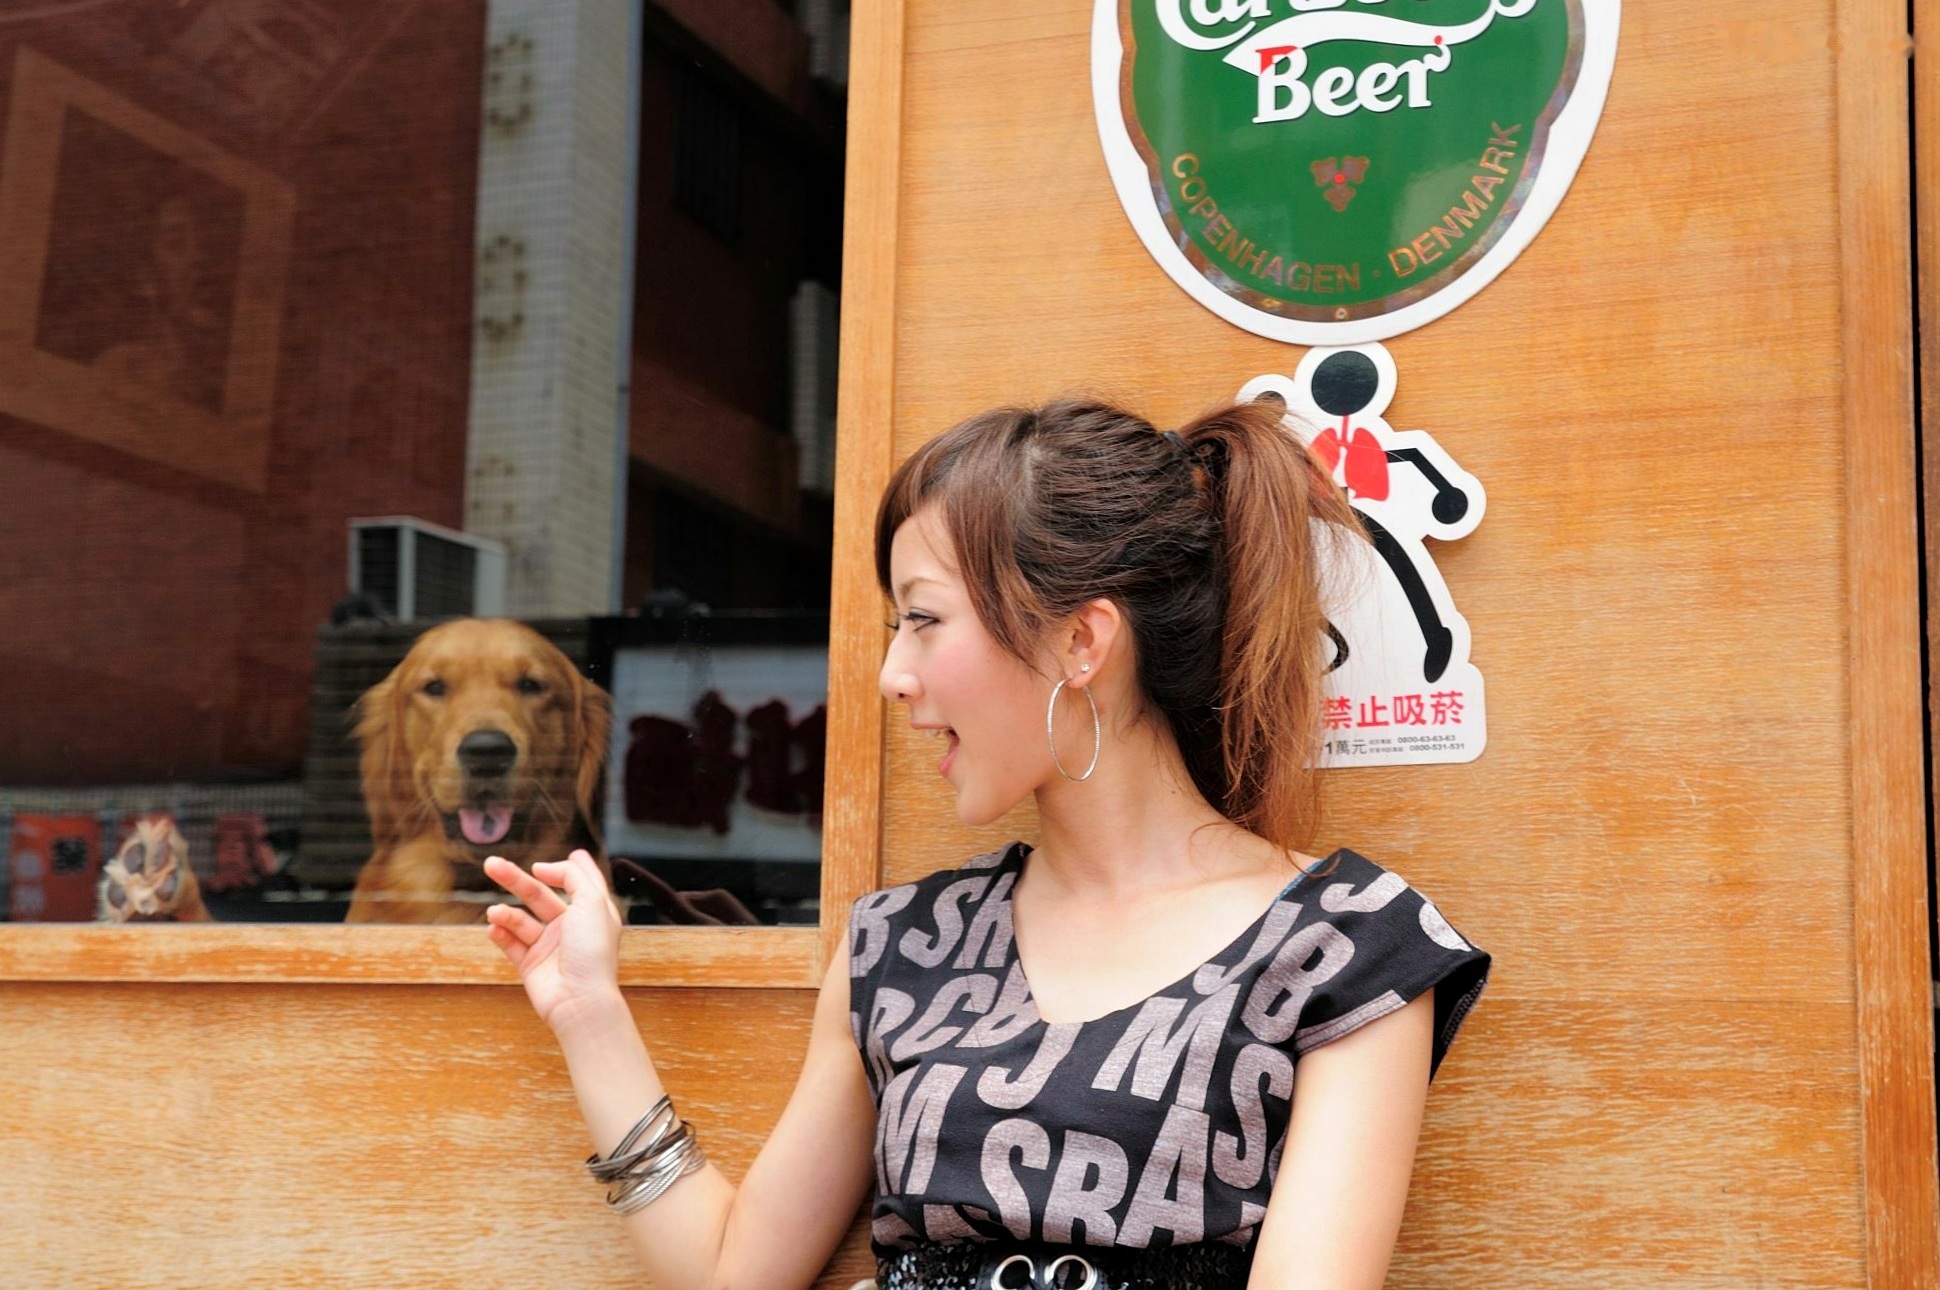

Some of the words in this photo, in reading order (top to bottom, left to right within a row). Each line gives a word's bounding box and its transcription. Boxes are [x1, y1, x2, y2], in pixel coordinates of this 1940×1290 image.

[1251, 44, 1452, 124] Beer
[1171, 152, 1361, 293] COPENHAGEN
[1387, 120, 1522, 278] DENMARK
[1322, 690, 1465, 730] 禁止吸菸
